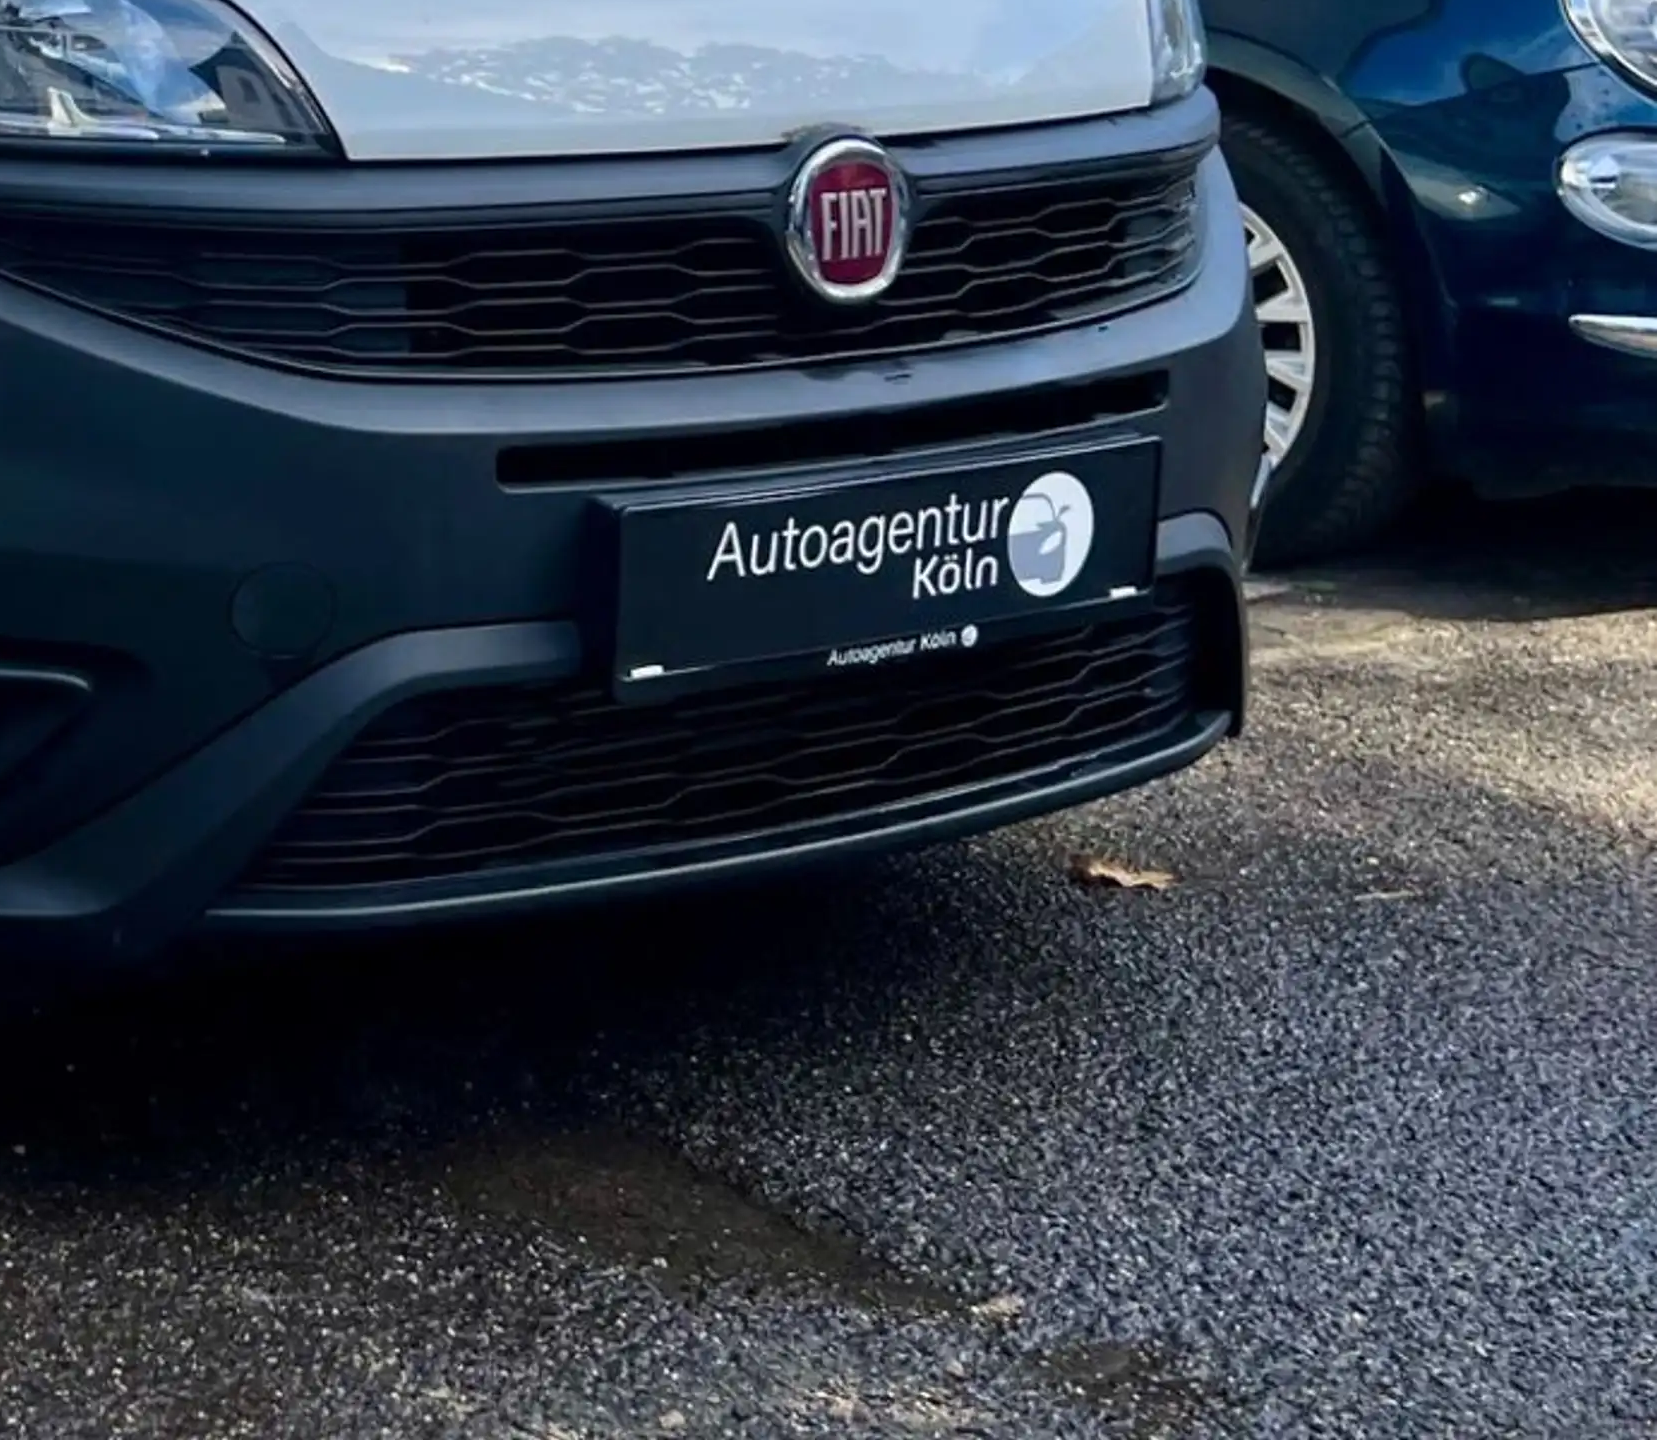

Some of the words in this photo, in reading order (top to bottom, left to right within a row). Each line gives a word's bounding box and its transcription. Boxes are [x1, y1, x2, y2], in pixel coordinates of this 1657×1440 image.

[820, 187, 887, 261] FIAT
[706, 492, 1010, 582] Autoagentur
[911, 547, 999, 600] Köln
[826, 638, 917, 666] Autoagentur
[920, 630, 957, 651] Köln
